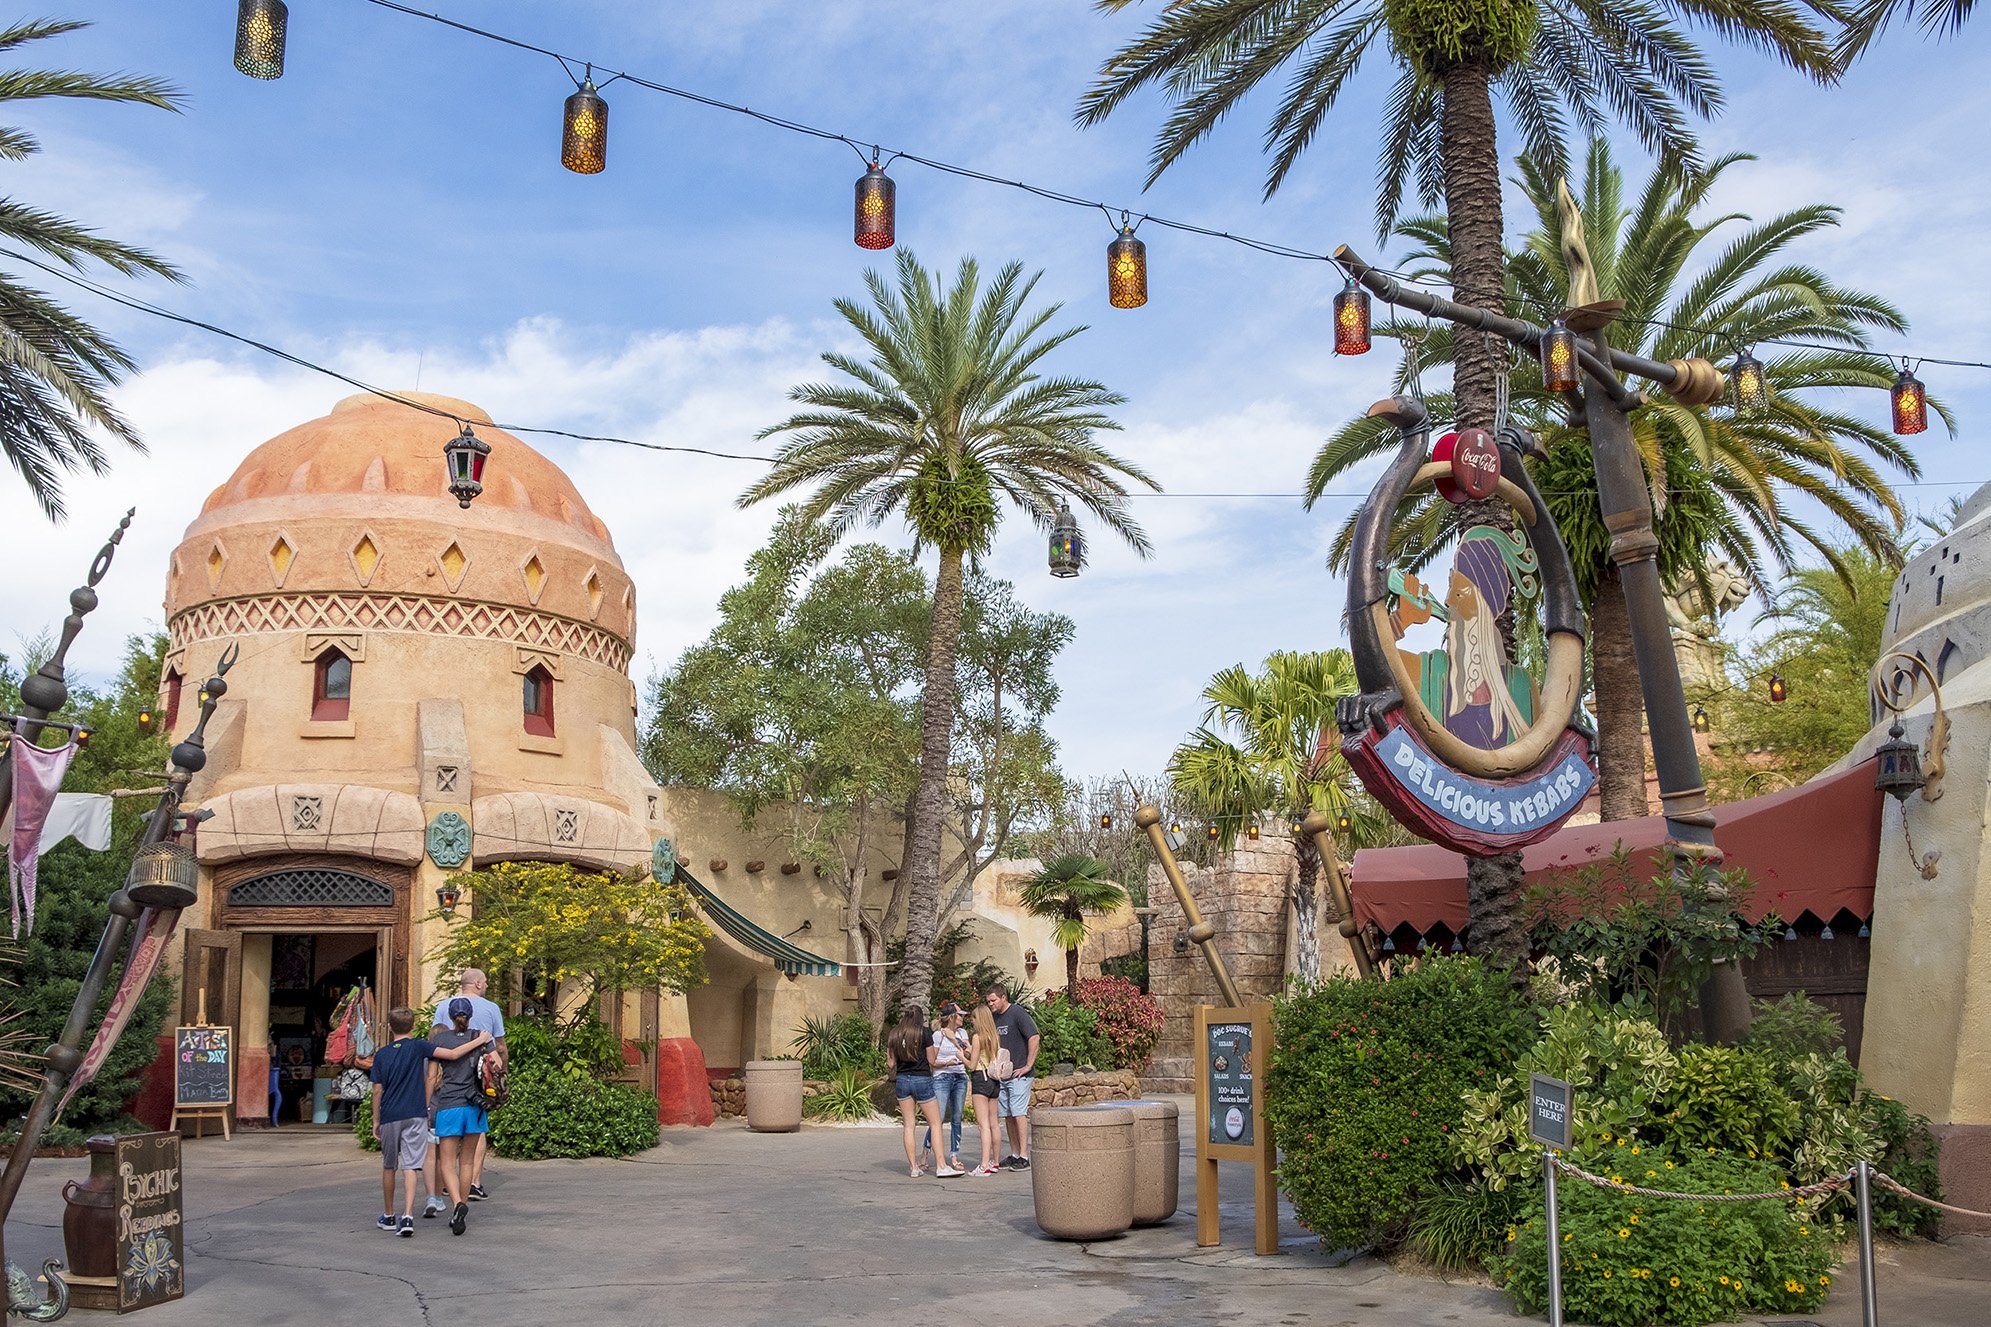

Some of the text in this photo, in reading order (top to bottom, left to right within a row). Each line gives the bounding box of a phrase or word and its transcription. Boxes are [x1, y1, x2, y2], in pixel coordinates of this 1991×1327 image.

[1461, 448, 1497, 473] Coca-Cola
[1394, 742, 1581, 826] DELICIOUS KEBABS
[1212, 1024, 1252, 1038] DOC SUGRUE'S
[181, 1050, 228, 1064] OF the DAY
[1218, 1085, 1244, 1095] 100+ drink
[1218, 1095, 1250, 1103] choices here!
[1535, 1095, 1566, 1112] ENTER
[1538, 1107, 1563, 1123] HERE
[119, 1161, 179, 1205] PSYCHIC
[119, 1203, 180, 1245] READINGS
